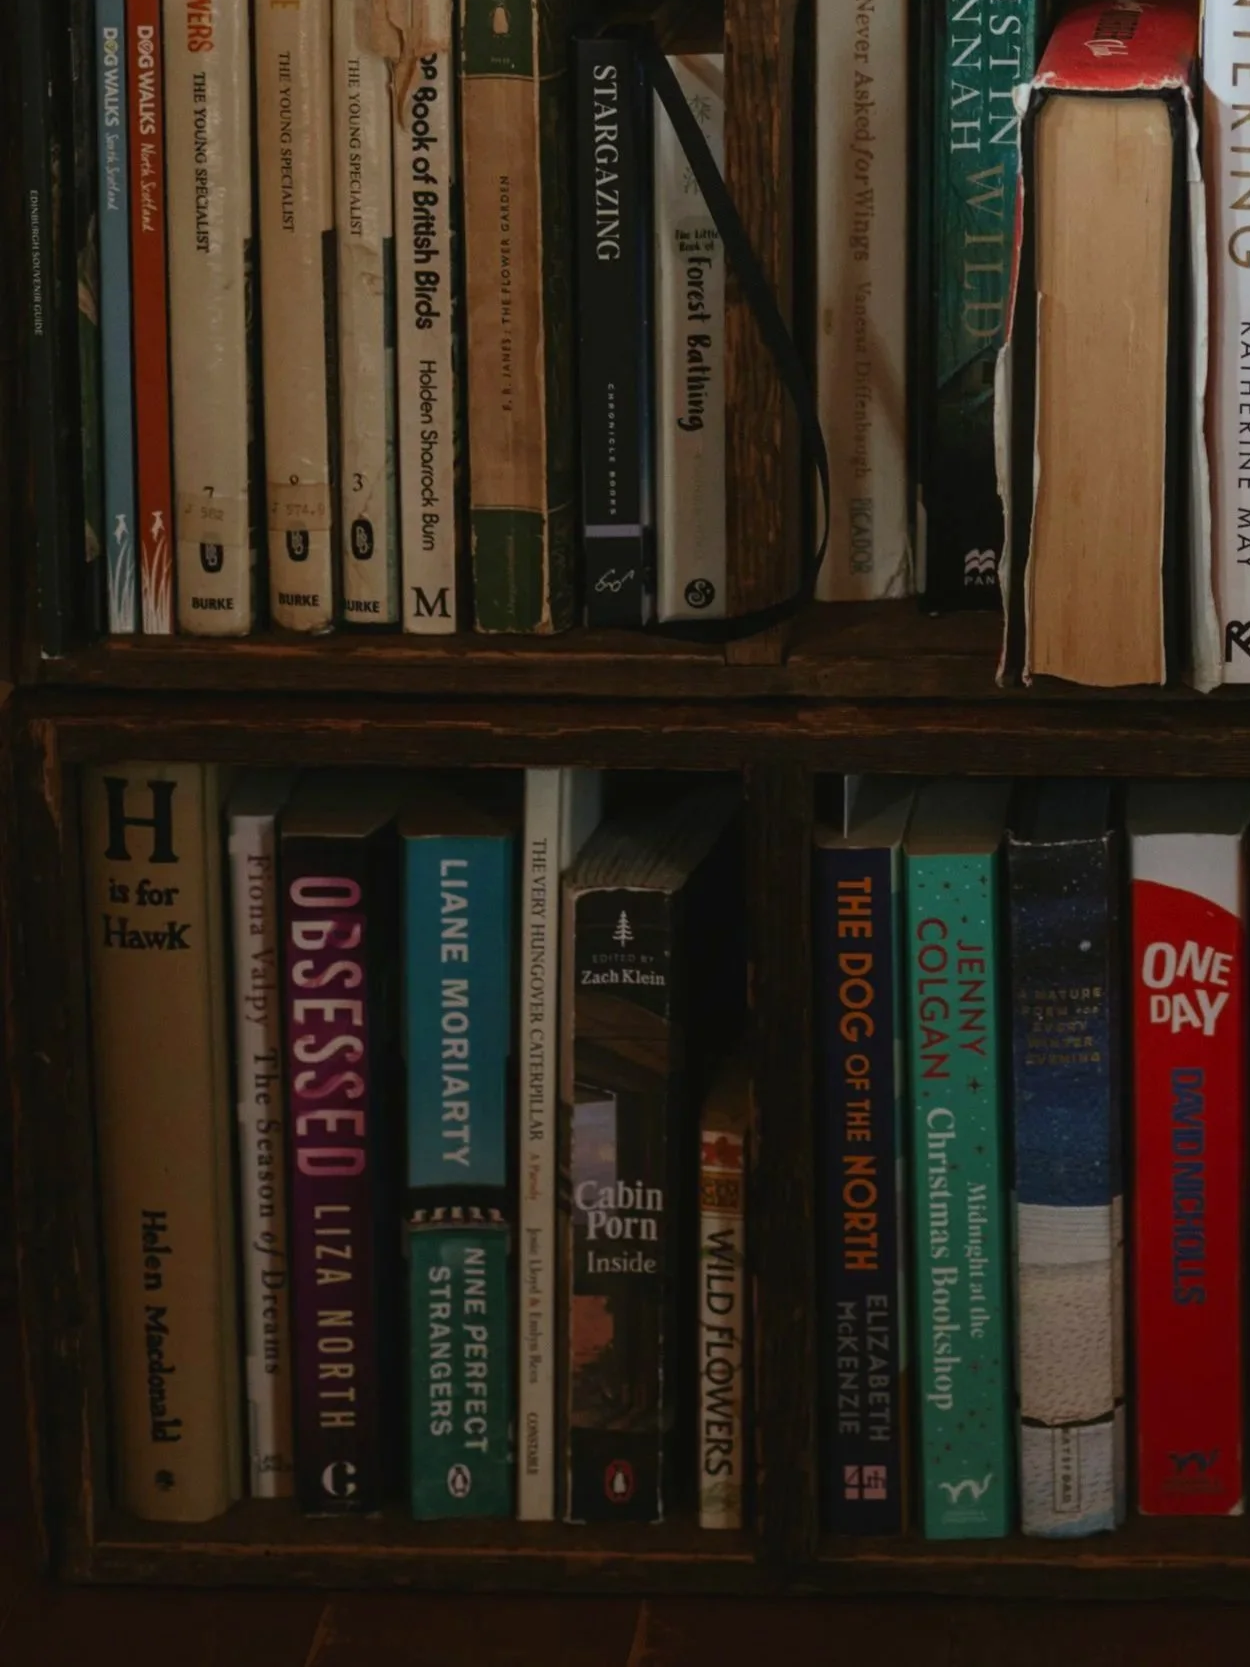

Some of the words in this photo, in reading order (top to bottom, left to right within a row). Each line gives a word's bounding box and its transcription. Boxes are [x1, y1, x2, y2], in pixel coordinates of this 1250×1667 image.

[103, 27, 119, 66] DOG
[137, 24, 154, 68] DOG
[279, 52, 291, 83] THE
[347, 58, 360, 87] THE
[104, 68, 119, 126] WALKS
[138, 71, 155, 135] WALKS
[194, 72, 206, 103] THE
[279, 87, 292, 143] YOUNG
[411, 87, 438, 150] Book
[854, 70, 877, 141] Asked
[194, 108, 207, 163] YOUNG
[348, 93, 361, 149] YOUNG
[105, 166, 119, 211] Scotland
[139, 142, 155, 176] North
[281, 148, 294, 233] SPECIALIST
[414, 157, 438, 184] of
[593, 65, 621, 261] STARGAZING
[849, 144, 876, 185] for
[139, 181, 156, 232] Scotland
[195, 168, 209, 253] SPECIALIST
[350, 153, 362, 237] SPECIALIST
[499, 175, 510, 232] GARDEN
[850, 188, 875, 262] Wings
[412, 191, 439, 264] British
[962, 163, 1005, 338] WILD
[500, 238, 511, 293] FLOWER
[686, 257, 712, 322] Forest
[33, 304, 44, 336] GUIDE
[414, 270, 440, 329] Birds
[501, 299, 512, 324] THE
[853, 281, 871, 353] Vanessa
[419, 360, 438, 424] Holden
[678, 334, 712, 431] Bathing
[607, 383, 616, 463] CHRONICLE
[849, 360, 873, 479] Diffenbaugh
[352, 474, 364, 492] 3
[420, 430, 440, 507] Sharrock
[609, 471, 617, 516] BOOKS
[422, 513, 442, 551] Burn
[849, 497, 874, 575] PICADOR
[192, 597, 234, 610] BURKE
[279, 593, 320, 607] BURKE
[411, 587, 452, 619] M
[964, 575, 996, 586] PAN
[103, 777, 179, 863] H
[531, 838, 547, 872] THE
[109, 878, 130, 904] is
[135, 878, 179, 906] for
[246, 853, 271, 935] Fiona
[440, 858, 469, 963] LIANE
[531, 877, 546, 918] VERY
[836, 876, 872, 938] THE
[244, 947, 276, 1028] Valpy
[529, 923, 545, 1024] HUNGOVER
[581, 970, 619, 985] Zach
[623, 969, 665, 986] Klein
[592, 953, 636, 963] EDITED
[1142, 940, 1233, 990] ONE
[838, 952, 875, 1043] DOG
[917, 917, 950, 1080] COLGAN
[956, 939, 986, 1057] JENNY
[1034, 986, 1103, 1000] NATURE
[1150, 988, 1230, 1037] DAY
[289, 875, 366, 1177] OBSESSED
[254, 1048, 278, 1106] The
[440, 978, 471, 1167] MORIARTY
[529, 1029, 544, 1141] CATERPILLAR
[845, 1053, 871, 1091] OF
[845, 1098, 871, 1142] THE
[1170, 1066, 1206, 1156] DAVID
[257, 1117, 280, 1218] Season
[575, 1180, 664, 1212] Cabin
[926, 1106, 958, 1259] Christmas
[253, 1230, 283, 1257] of
[586, 1212, 658, 1242] Porn
[841, 1155, 879, 1270] NORTH
[963, 1181, 988, 1277] Midnight
[1172, 1161, 1208, 1306] NICHOLLS
[142, 1210, 172, 1290] Helen
[314, 1203, 352, 1286] LIZA
[587, 1250, 657, 1274] Inside
[706, 1228, 736, 1314] WILD
[464, 1247, 487, 1315] NINE
[525, 1259, 541, 1294] Lloyd
[969, 1282, 987, 1302] at
[261, 1269, 287, 1375] Dreams
[428, 1266, 453, 1437] STRANGERS
[926, 1265, 960, 1411] Bookshop
[969, 1306, 990, 1339] the
[144, 1305, 183, 1443] Macdonald
[316, 1309, 356, 1429] NORTH
[462, 1323, 489, 1453] PERFECT
[704, 1321, 735, 1477] FLOWERS
[835, 1301, 860, 1435] McKENZIE
[866, 1294, 891, 1441] ELIZABETH
[526, 1412, 538, 1475] CONSTABLE
